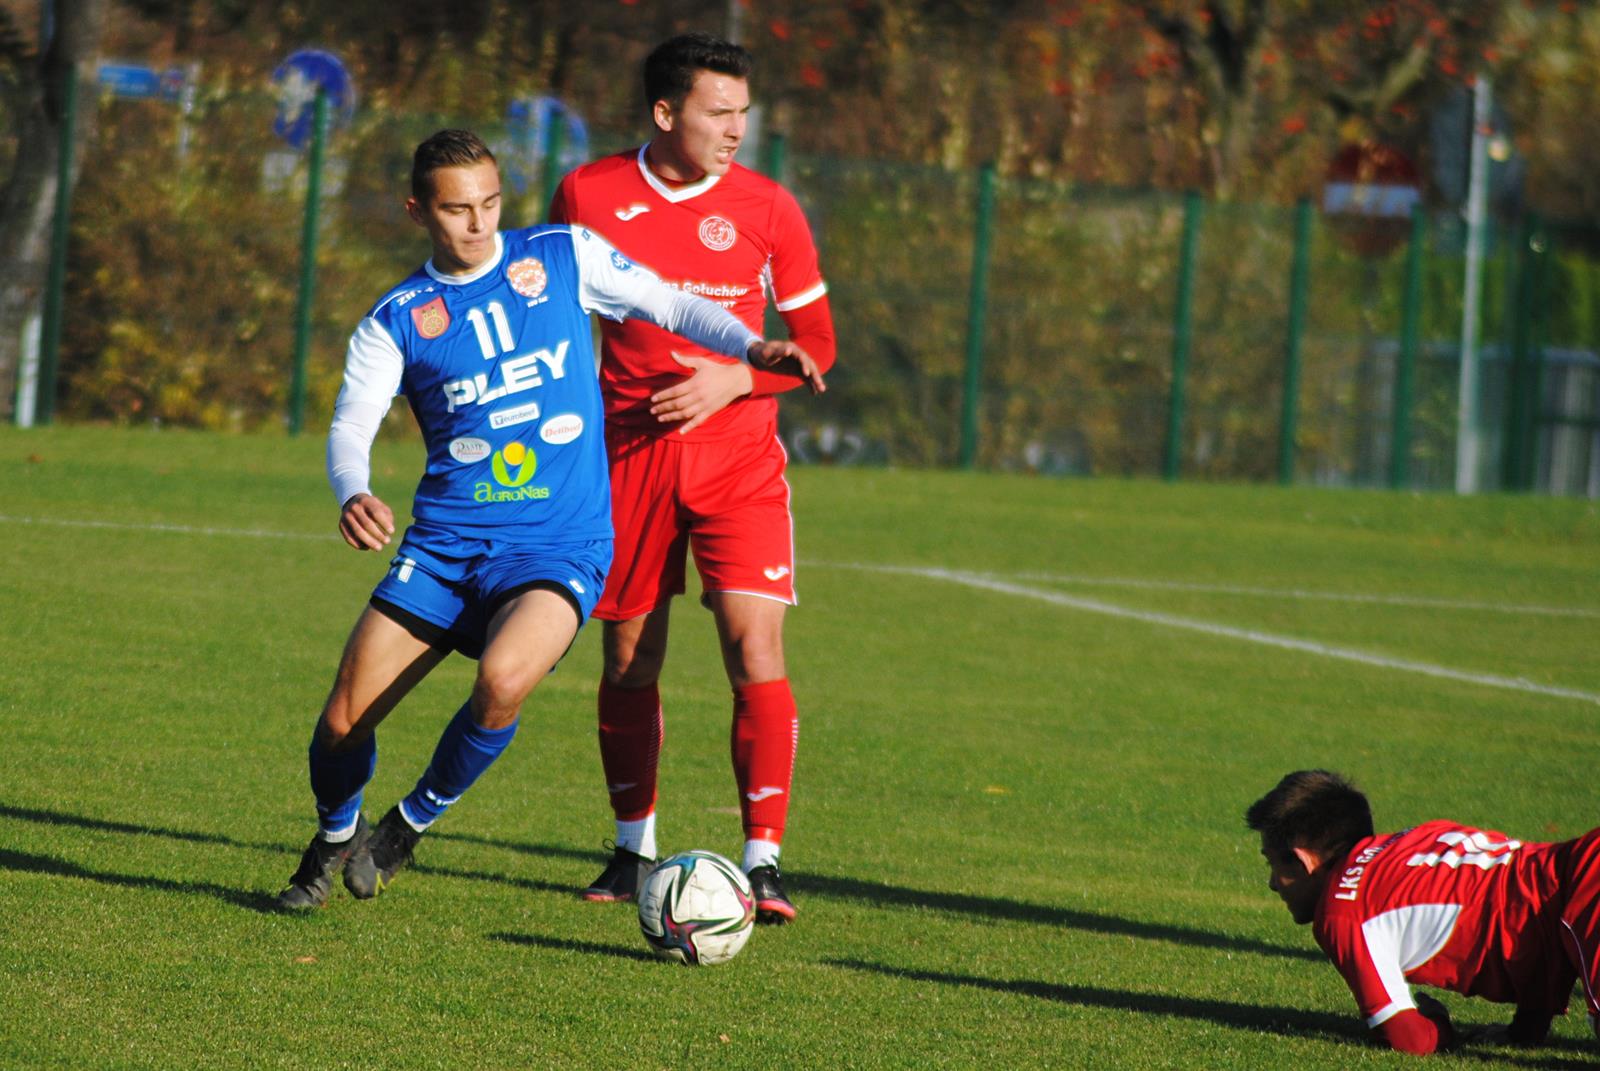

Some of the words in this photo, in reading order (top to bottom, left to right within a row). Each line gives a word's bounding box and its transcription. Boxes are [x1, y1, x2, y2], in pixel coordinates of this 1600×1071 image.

[682, 281, 749, 298] Gołuchów
[466, 301, 516, 361] 11
[443, 340, 571, 414] PLEY
[1334, 865, 1365, 902] LKS
